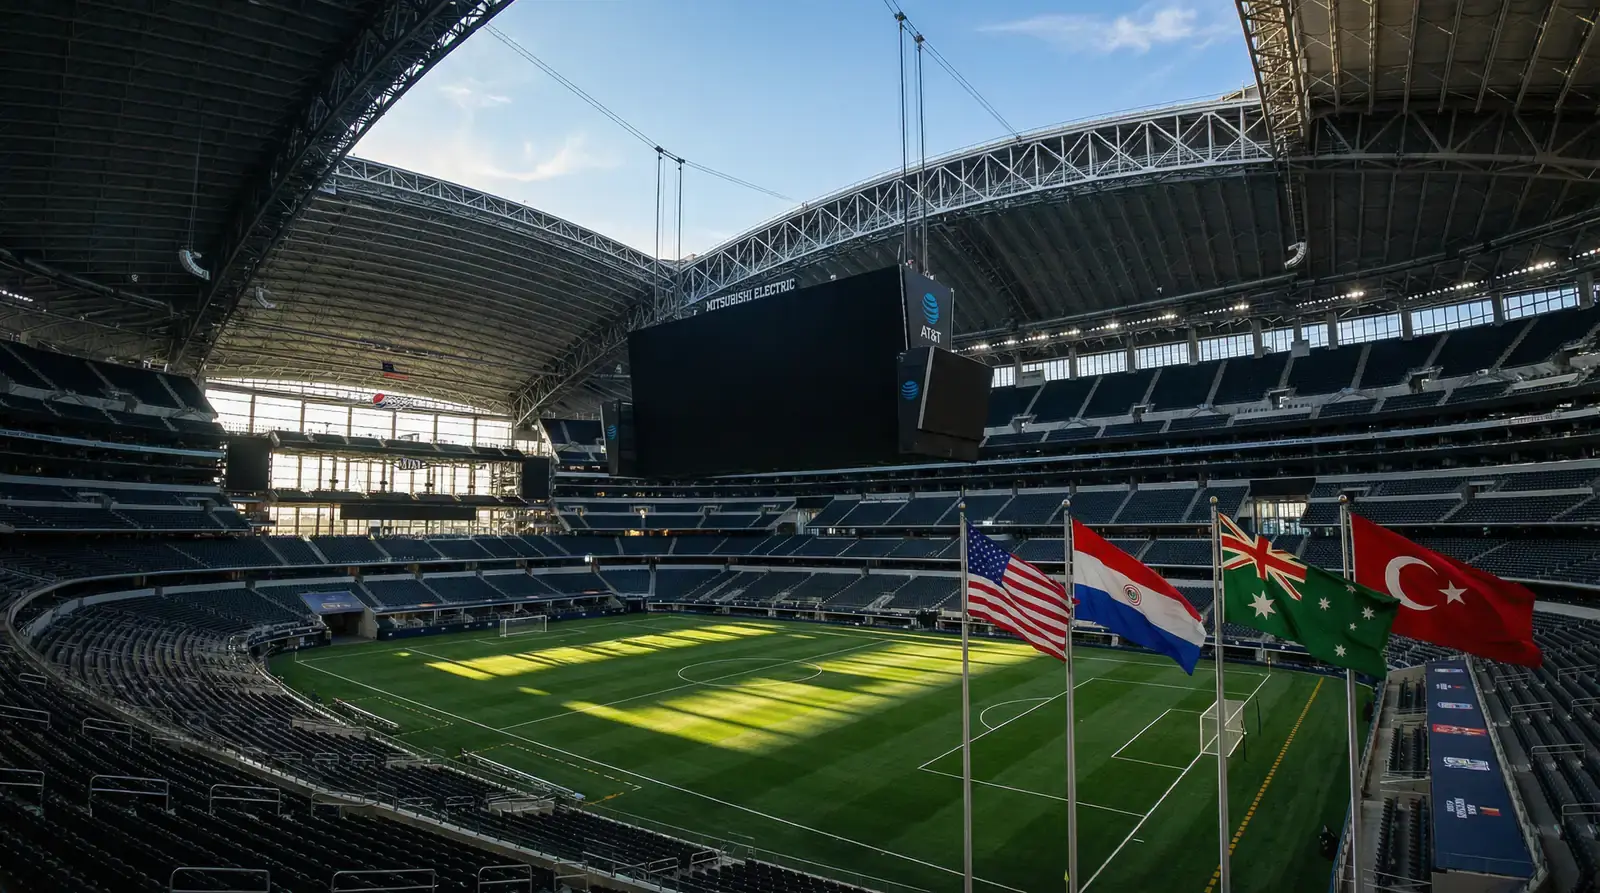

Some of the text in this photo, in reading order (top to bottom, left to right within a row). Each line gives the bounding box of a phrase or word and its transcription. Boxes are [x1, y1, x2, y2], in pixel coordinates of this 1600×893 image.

[706, 278, 795, 312] MITSUBISHI ELECTRIC
[920, 325, 941, 344] AT&T
